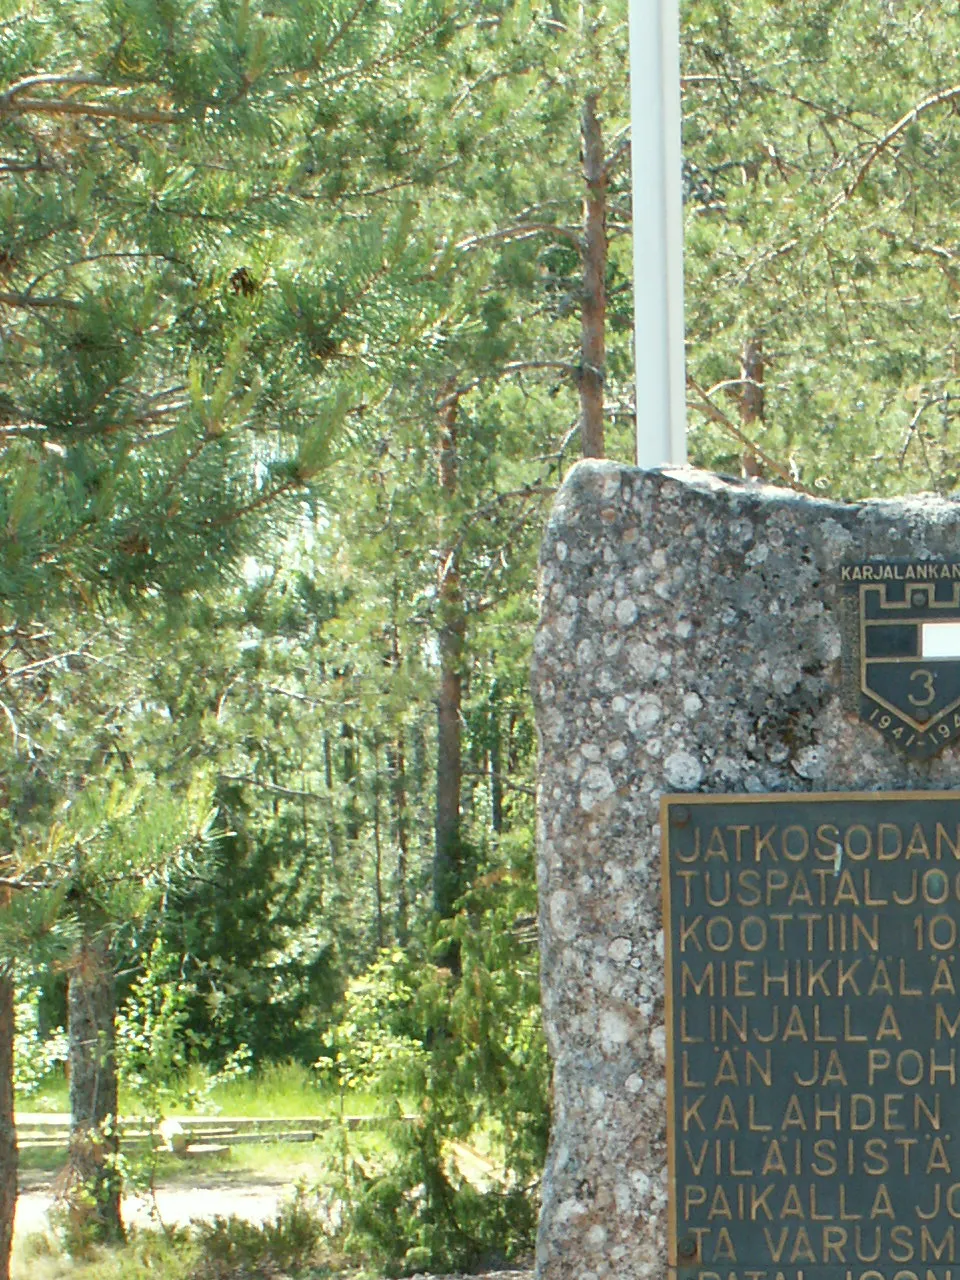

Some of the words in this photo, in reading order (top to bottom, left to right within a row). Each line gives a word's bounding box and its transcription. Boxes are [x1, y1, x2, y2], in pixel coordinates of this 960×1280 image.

[907, 669, 936, 706] 3
[678, 914, 881, 953] KOOTTIIN
[679, 1004, 902, 1043] LINJALLA
[681, 1046, 771, 1088] LÄN
[794, 1050, 847, 1087] JA
[682, 1094, 942, 1132] KALAHDEN
[685, 1134, 952, 1176] VILÄISISTÄ
[684, 1183, 895, 1221] PAIKALLA
[689, 1227, 737, 1261] TA
